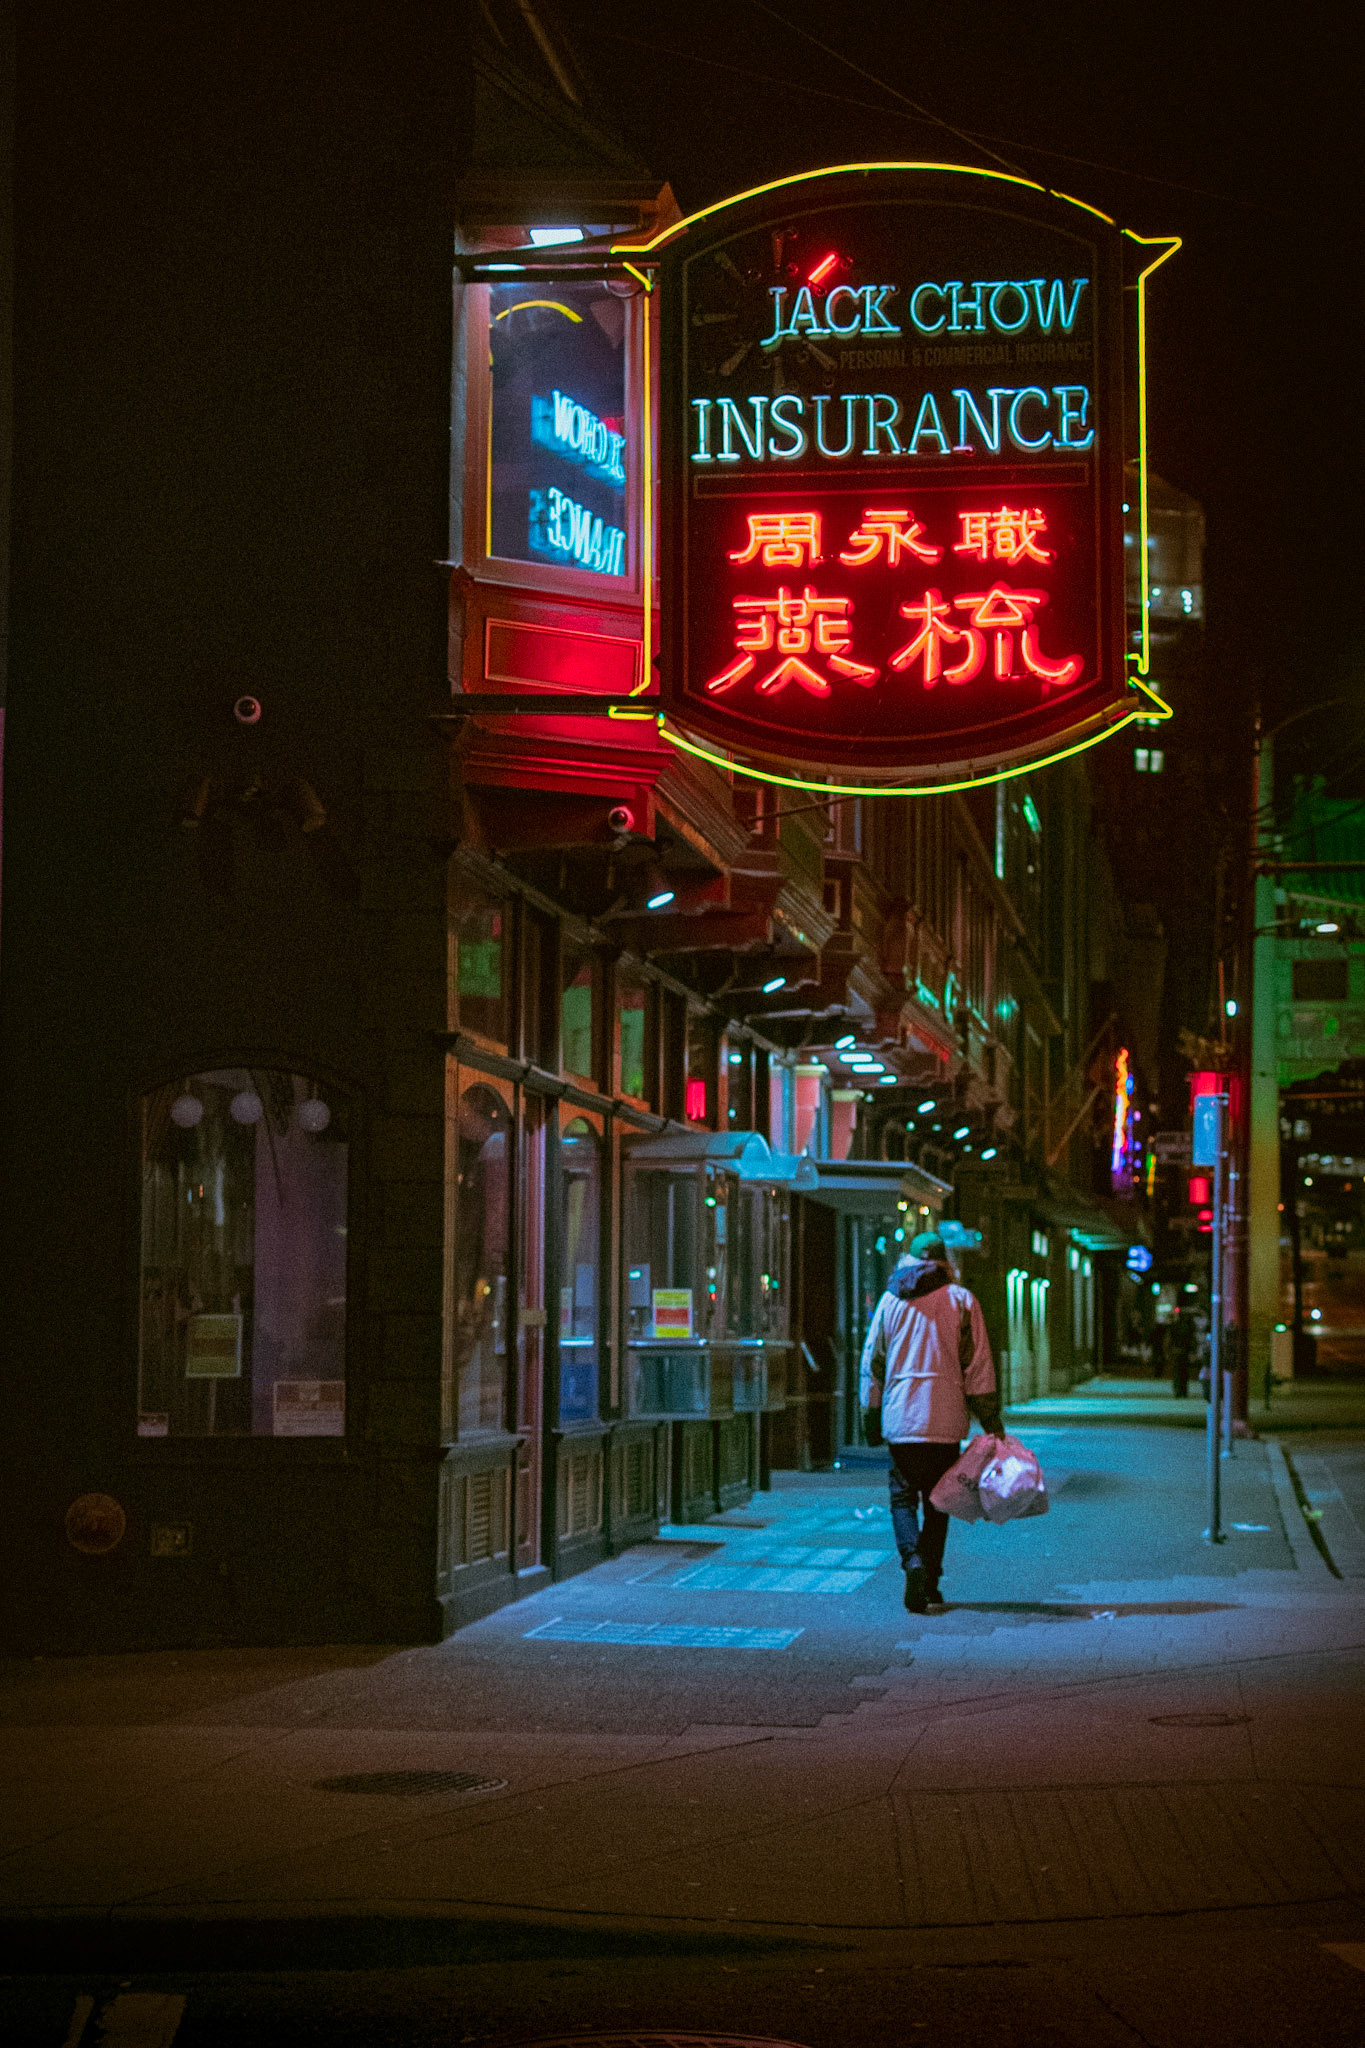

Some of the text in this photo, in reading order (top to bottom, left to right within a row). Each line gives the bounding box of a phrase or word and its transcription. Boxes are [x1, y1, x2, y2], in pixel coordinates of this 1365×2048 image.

[761, 278, 1089, 348] JACK CHOW
[839, 341, 1092, 369] PERSONAL & COMMERCIAL INSURANCE
[690, 386, 1096, 462] INSURANCE
[729, 505, 1058, 567] 周永職
[707, 583, 1084, 695] 燕梳
